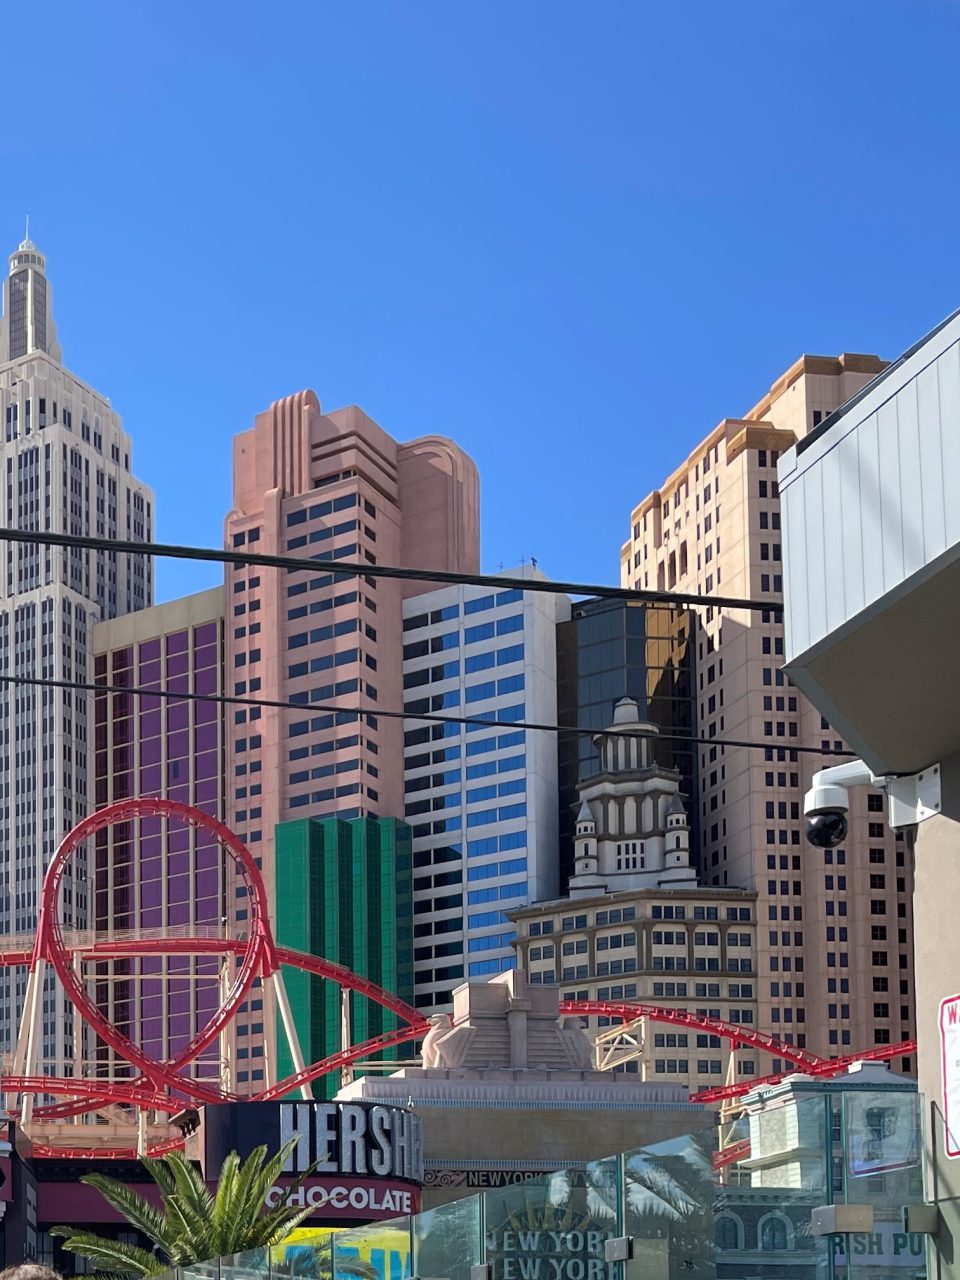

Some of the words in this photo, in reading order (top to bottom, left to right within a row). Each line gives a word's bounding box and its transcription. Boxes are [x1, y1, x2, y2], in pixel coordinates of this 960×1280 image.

[265, 1185, 412, 1213] CHOCOLATE
[548, 1231, 614, 1253] YOR
[893, 1232, 923, 1257] PU
